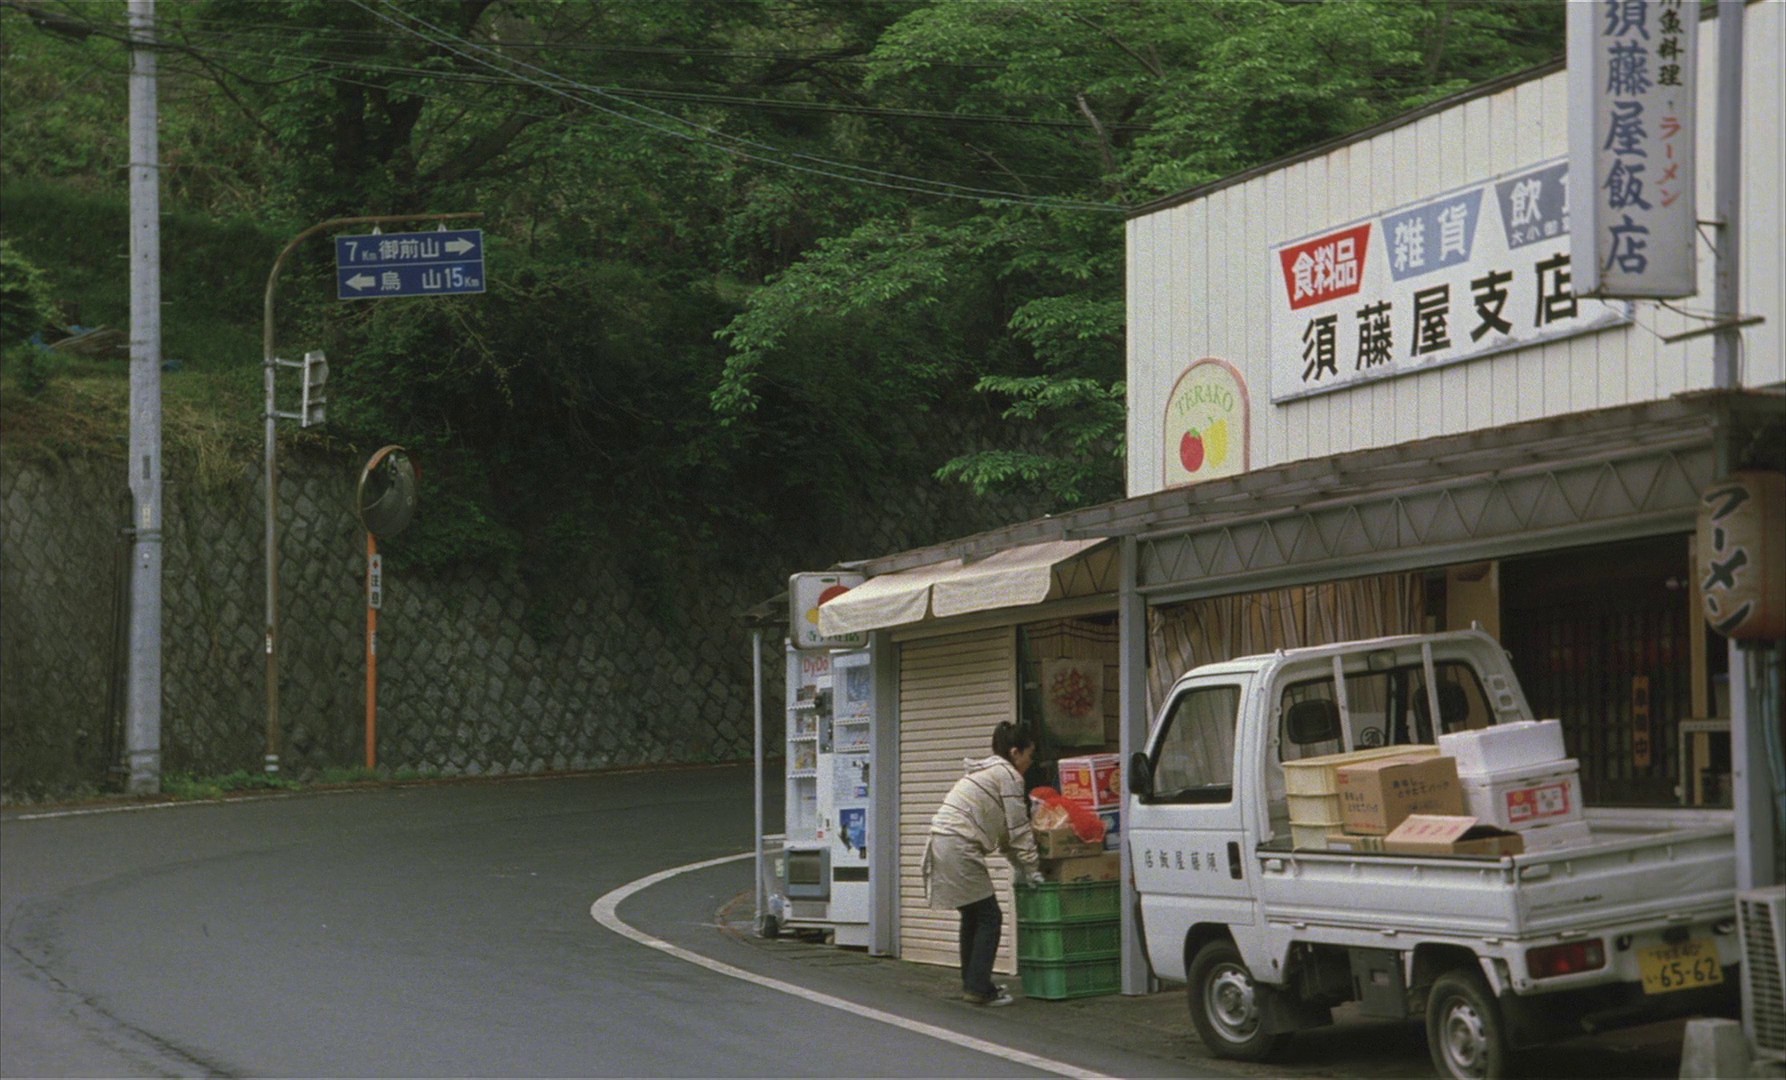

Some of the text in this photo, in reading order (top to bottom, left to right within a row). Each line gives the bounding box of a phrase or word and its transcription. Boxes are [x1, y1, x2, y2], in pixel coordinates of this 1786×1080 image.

[378, 238, 440, 261] 御前山
[1292, 237, 1357, 302] 食料品
[1302, 253, 1578, 383] 須藤屋支店
[1174, 384, 1235, 416] TERAKO
[1660, 957, 1719, 989] 65-62
